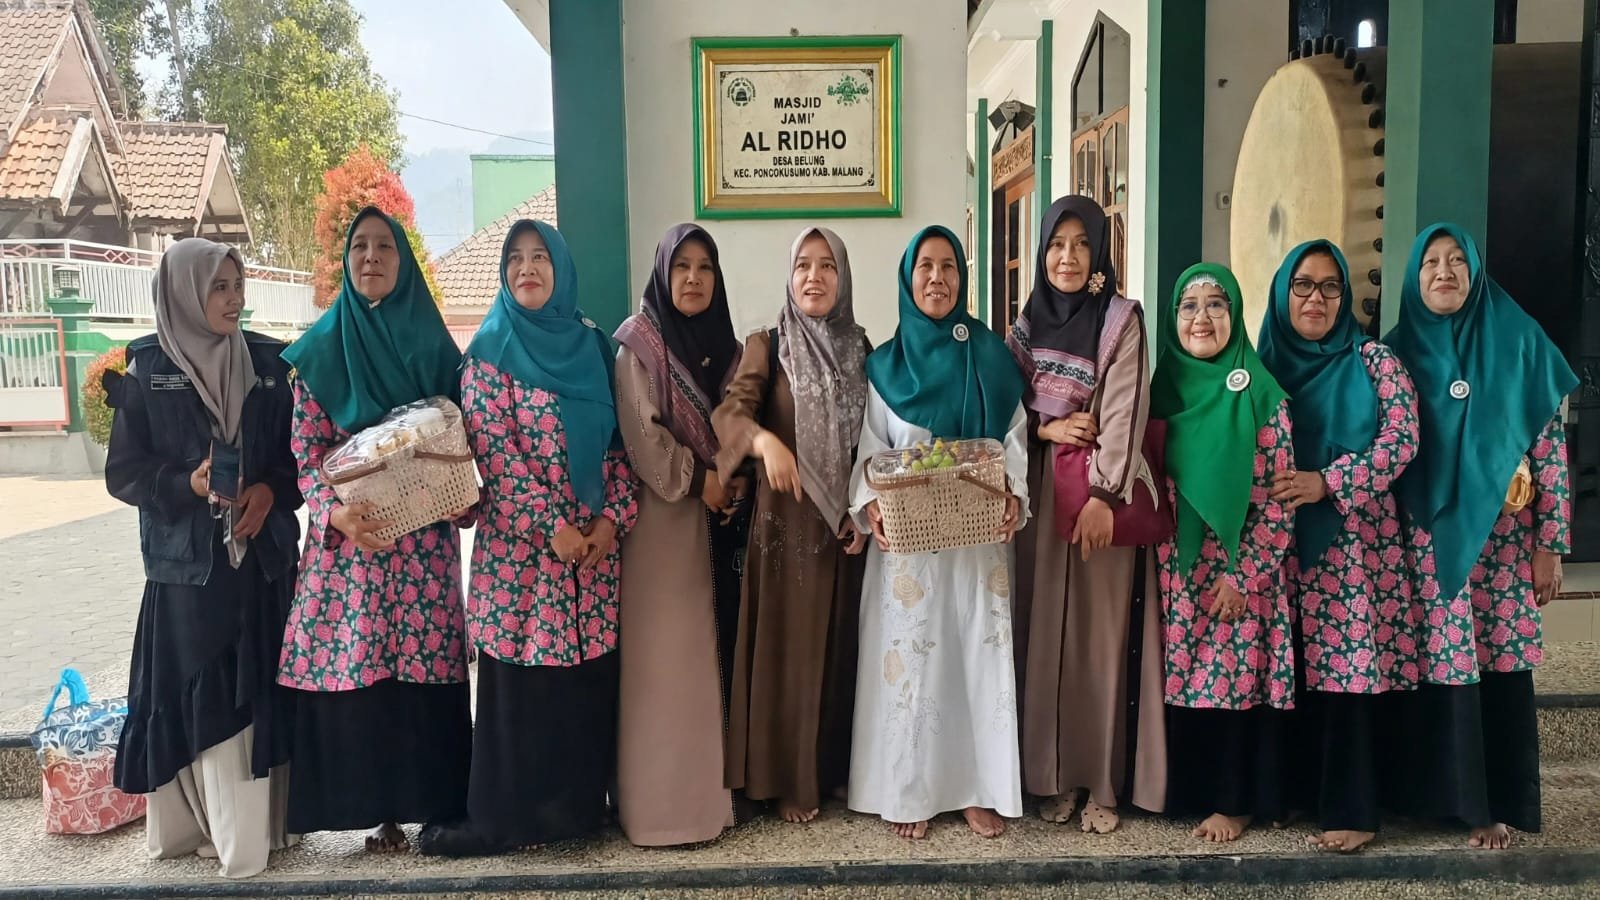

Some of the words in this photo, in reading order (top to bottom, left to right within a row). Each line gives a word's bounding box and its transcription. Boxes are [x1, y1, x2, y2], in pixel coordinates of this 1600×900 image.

[773, 96, 822, 109] MASJID
[740, 131, 771, 152] AL
[777, 129, 847, 151] RIDHO
[772, 155, 793, 167] DESA
[794, 155, 825, 166] BELUNG
[733, 168, 752, 178] KEC.
[753, 167, 811, 178] PONCOKUSUMO
[812, 166, 831, 177] KAB.
[831, 166, 864, 177] MALANG
